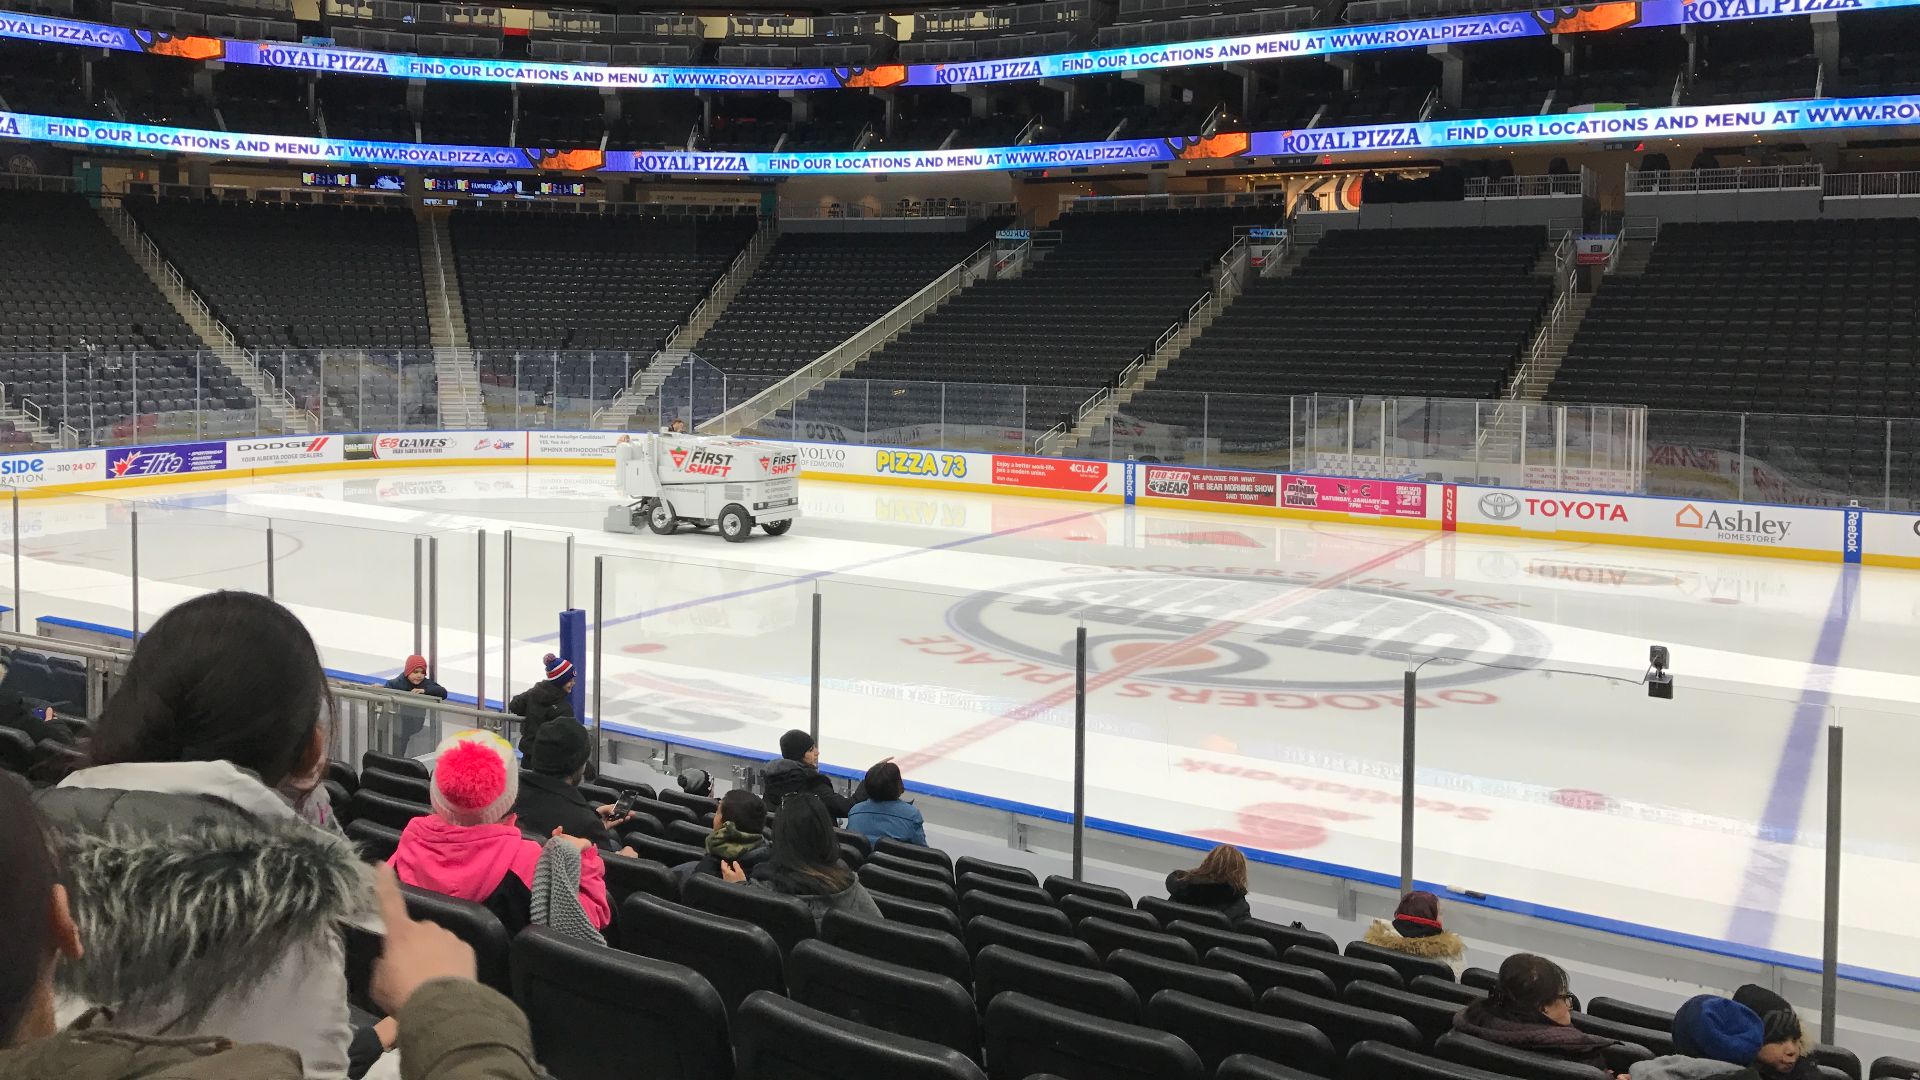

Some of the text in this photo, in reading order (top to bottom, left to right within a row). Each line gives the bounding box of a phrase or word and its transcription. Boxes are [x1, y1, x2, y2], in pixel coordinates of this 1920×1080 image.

[1062, 19, 1525, 72] FIND OUR LOCATIONS AND MENU AT WWW.ROYALPIZZA.CA
[259, 46, 389, 74] ROYAL PIZZA
[410, 63, 827, 86] FIND OUR LOCATIONS AND MENU AT WWW.ROYALPIZZA.CA
[936, 61, 1043, 85] ROYAL PIZZA
[1446, 104, 1920, 141] FIND OUR LOCATIONS AND MENU AT WWW.RO
[47, 124, 516, 164] FIND OUR LOCATIONS AND MENU AT WWW.ROYALPIZZA.CA
[1282, 128, 1422, 153] ROYAL PIZZA
[633, 154, 750, 172] ROYAL PIZZA
[769, 145, 1160, 170] FIND OUR LOCATIONS AND MENU AT WWW.ROYALPIZZA.CA
[237, 441, 314, 452] DODGE
[399, 438, 447, 448] GAMES
[139, 452, 183, 475] Elite
[691, 451, 733, 466] FIRST
[772, 455, 797, 465] FIRST
[799, 447, 846, 461] VOLVO
[56, 462, 97, 472] 310 24 07
[685, 463, 732, 478] SHIFT
[771, 463, 797, 475] SHIFT
[811, 461, 845, 469] EDMONTON
[876, 450, 967, 479] PIZZA 73
[1074, 464, 1099, 474] CLAC
[1126, 463, 1134, 497] Reebok
[1159, 481, 1189, 495] BEAR
[1193, 482, 1274, 493] THE BEAR MORNING SHOW
[1352, 497, 1380, 505] JANUARY
[1525, 499, 1629, 522] TOYOTA
[1705, 510, 1791, 540] Ashley
[1847, 511, 1859, 552] Reebok
[1718, 532, 1776, 544] HOMESTORE
[1360, 577, 1533, 611] PLACE
